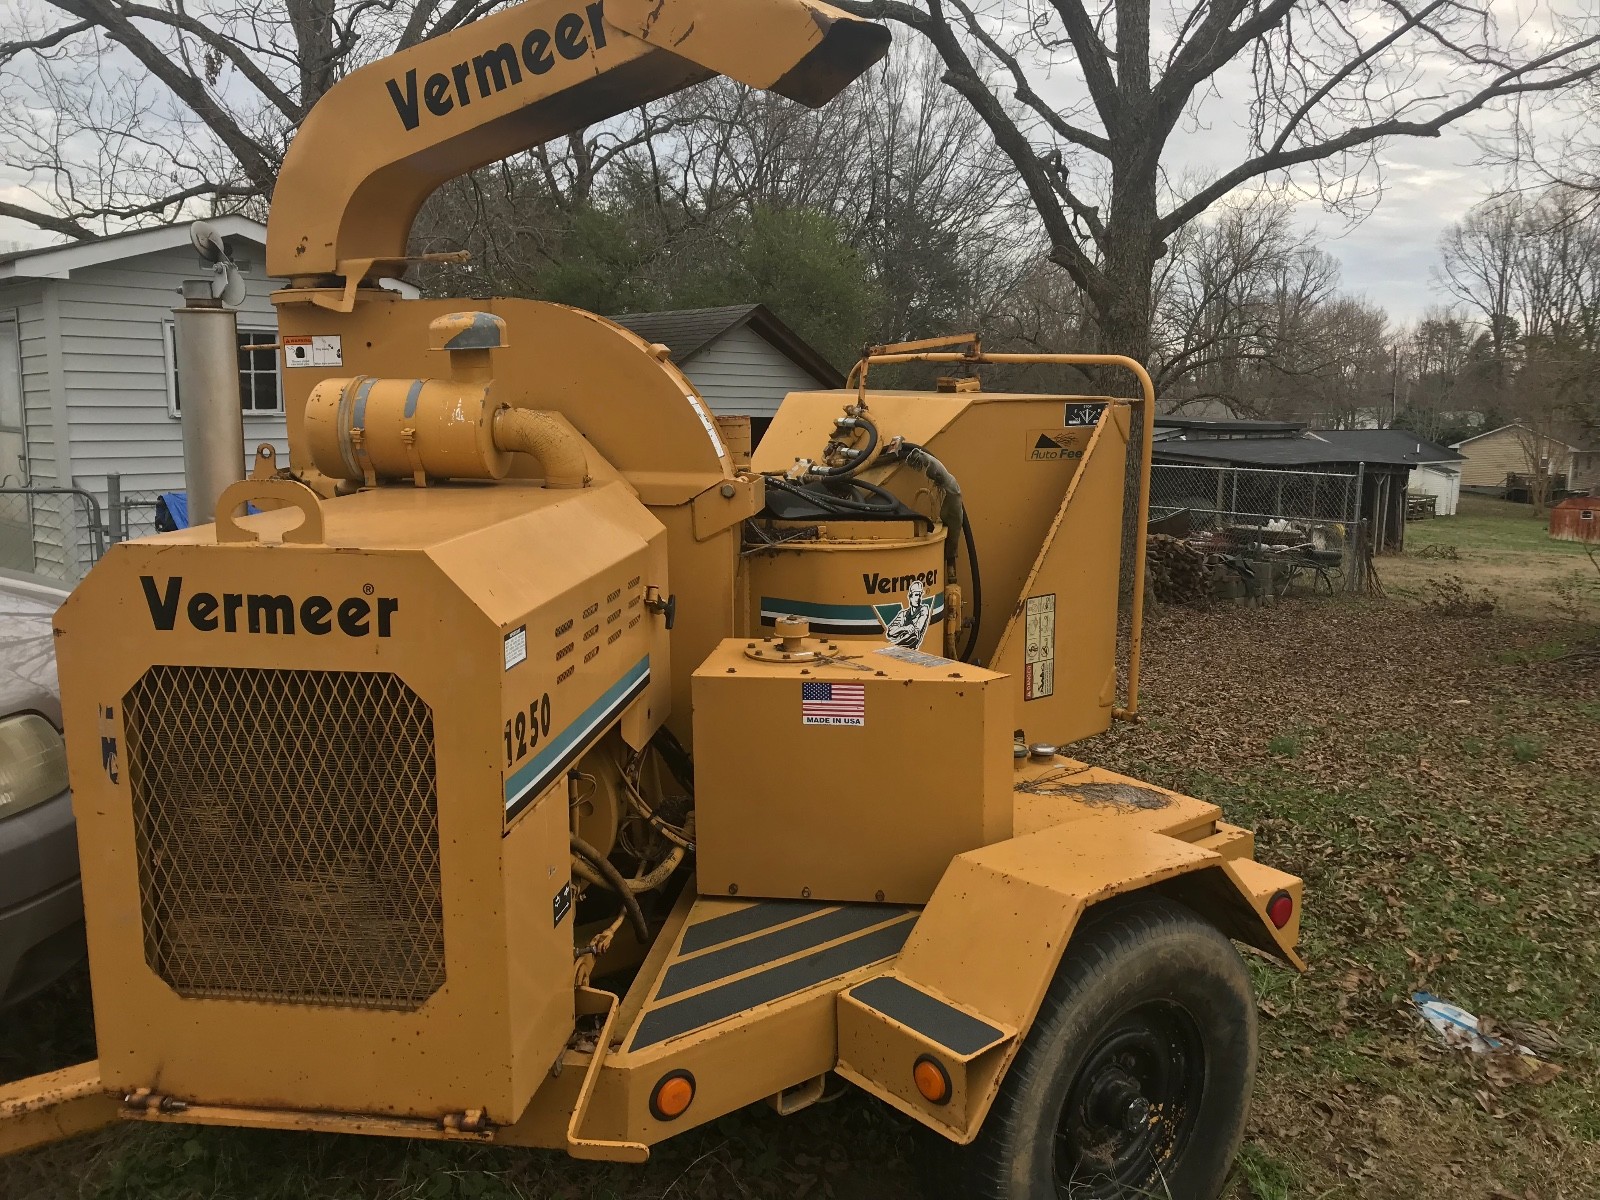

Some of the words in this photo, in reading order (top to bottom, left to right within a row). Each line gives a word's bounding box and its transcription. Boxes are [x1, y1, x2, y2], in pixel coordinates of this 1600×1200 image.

[385, 1, 607, 131] Vermeer
[1031, 449, 1057, 460] Auto
[1060, 448, 1083, 458] Fee
[139, 576, 398, 637] Vermeer
[862, 569, 938, 595] Vermeer
[504, 693, 550, 768] 1250
